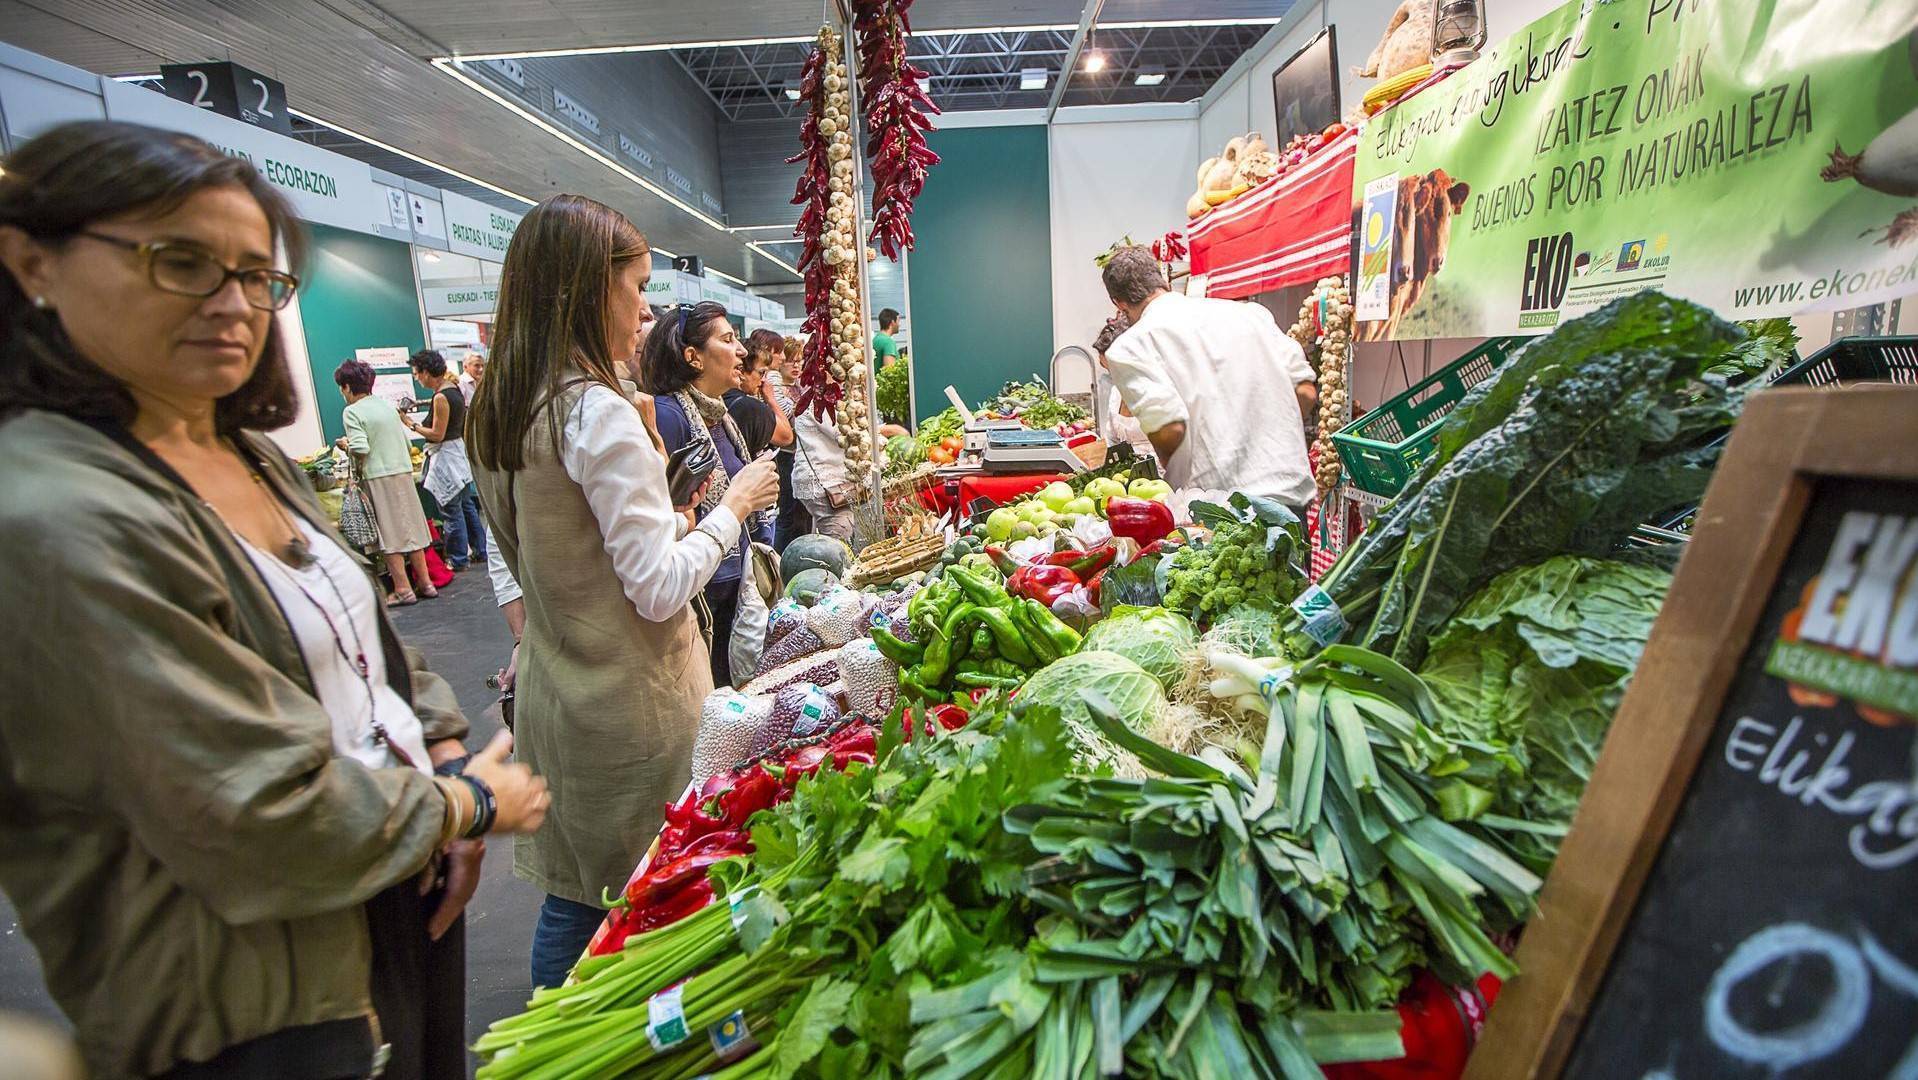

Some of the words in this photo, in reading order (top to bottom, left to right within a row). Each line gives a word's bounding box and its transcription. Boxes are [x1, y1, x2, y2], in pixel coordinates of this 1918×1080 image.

[187, 70, 214, 107] 2
[252, 79, 274, 118] 2
[1536, 85, 1628, 155] IZATEZ
[1636, 44, 1709, 124] ONAK
[1472, 173, 1537, 231] BUENOS
[1548, 155, 1605, 210] POR
[1619, 74, 1813, 195] NATURALEZA
[265, 158, 337, 198] ECORAZON
[452, 223, 481, 246] PATATAS
[481, 231, 487, 247] Y
[680, 258, 690, 272] 2
[1521, 231, 1573, 311] EKO
[447, 292, 478, 303] EUSKADI
